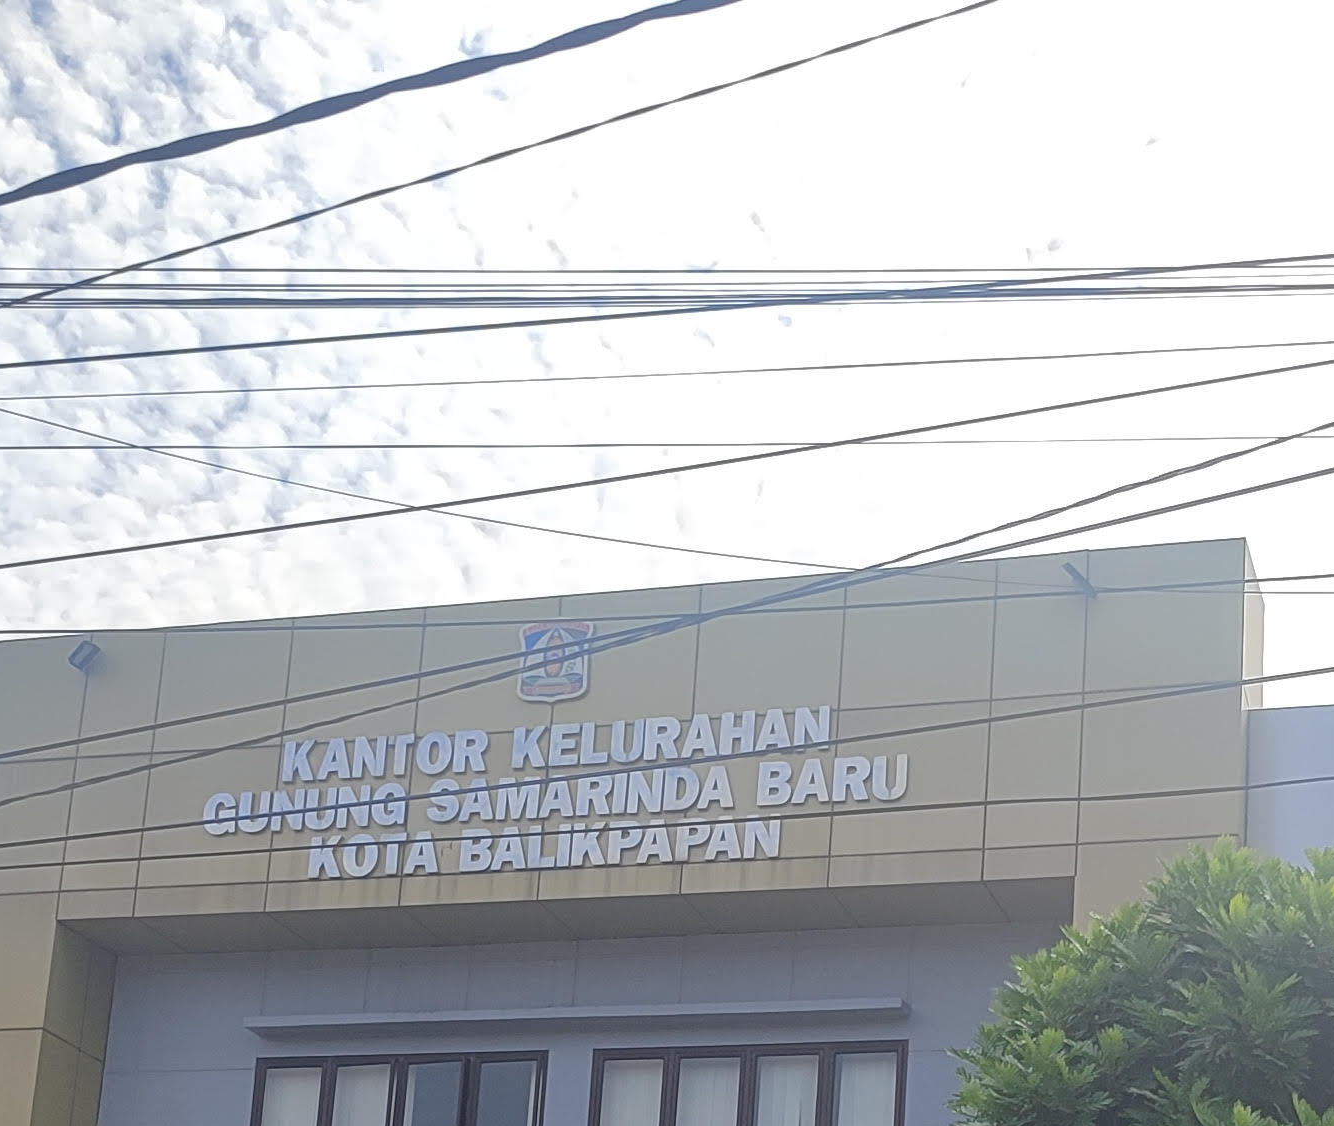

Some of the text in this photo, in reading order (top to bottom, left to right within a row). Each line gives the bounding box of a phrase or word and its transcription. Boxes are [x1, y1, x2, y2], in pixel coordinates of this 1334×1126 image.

[281, 705, 831, 783] KANTOR KELURAHAN
[202, 754, 909, 837] GUNUNG SAMARINDA BARU
[307, 815, 782, 880] KOTA BALIKPAPAN
